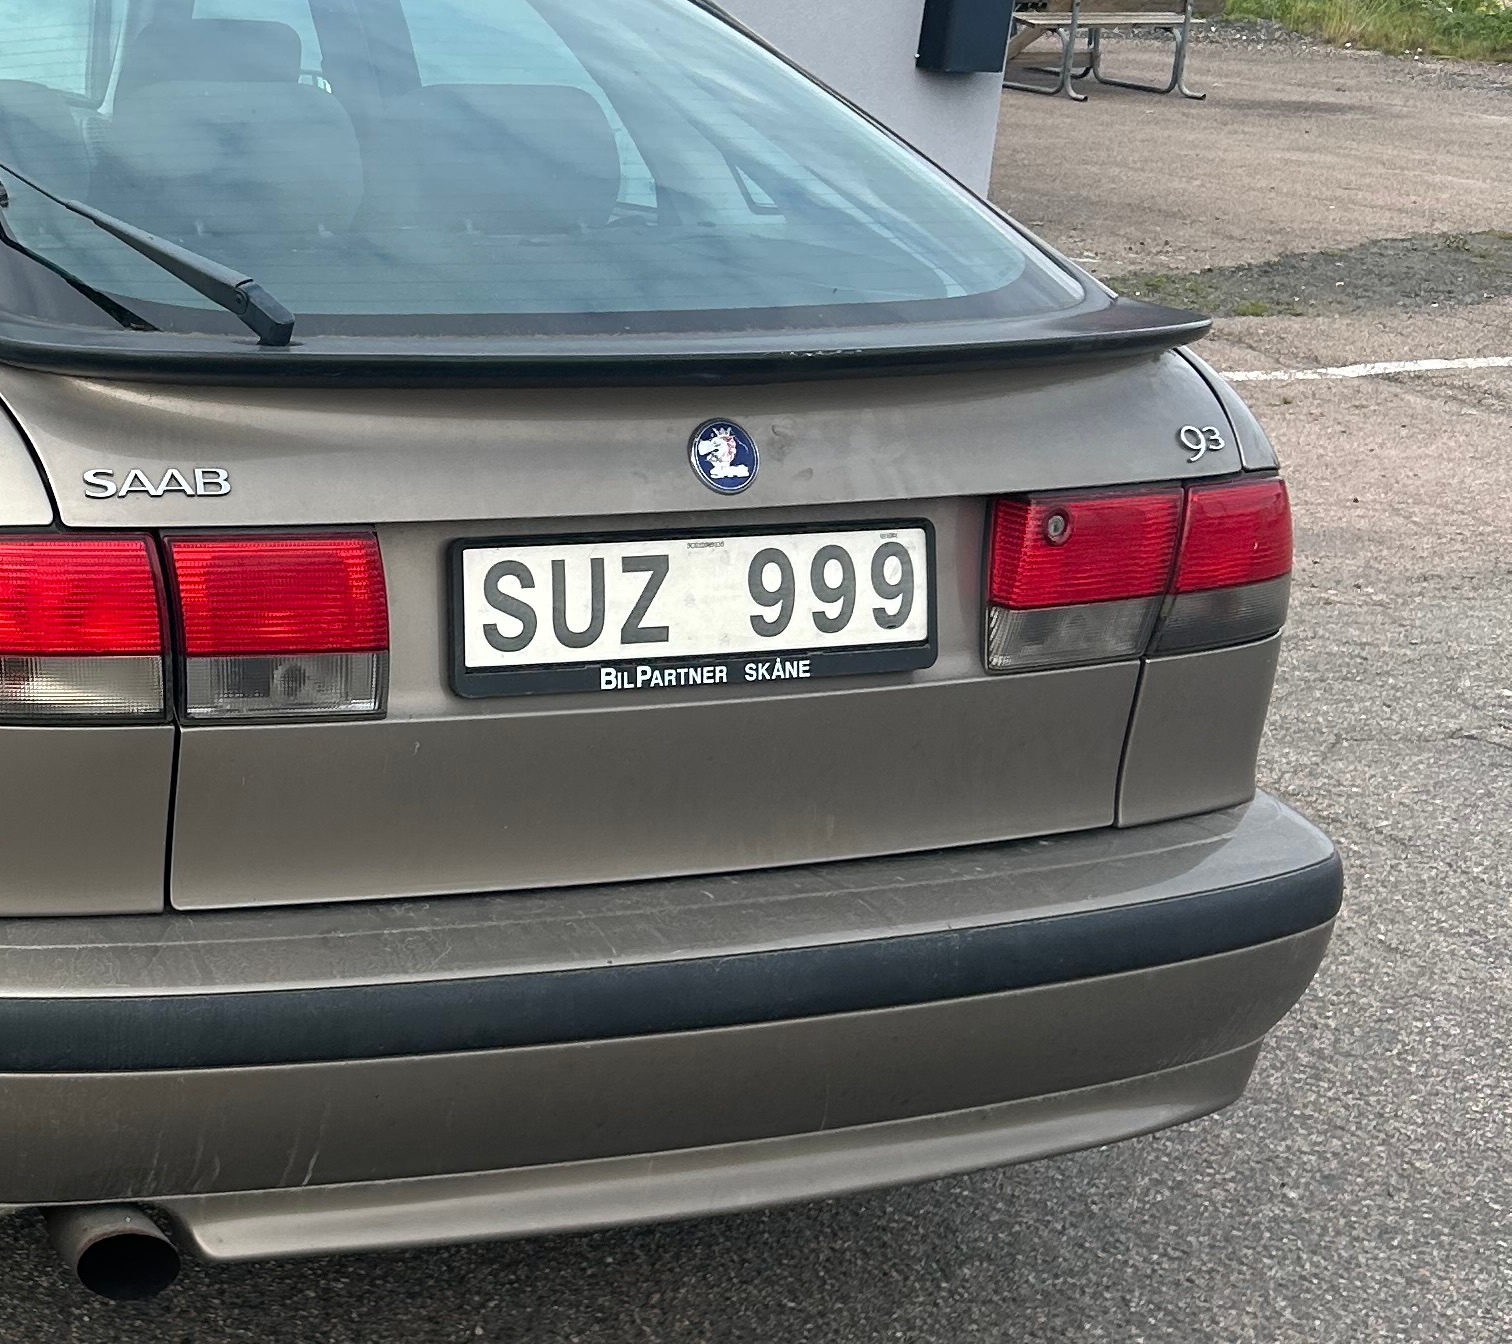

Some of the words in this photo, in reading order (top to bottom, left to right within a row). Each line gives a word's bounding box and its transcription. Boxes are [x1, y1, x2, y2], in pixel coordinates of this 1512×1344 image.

[1179, 425, 1226, 463] 93
[83, 468, 232, 499] SAAB
[482, 554, 670, 653] SUZ
[747, 541, 915, 638] 999
[744, 658, 811, 681] SKÅNE
